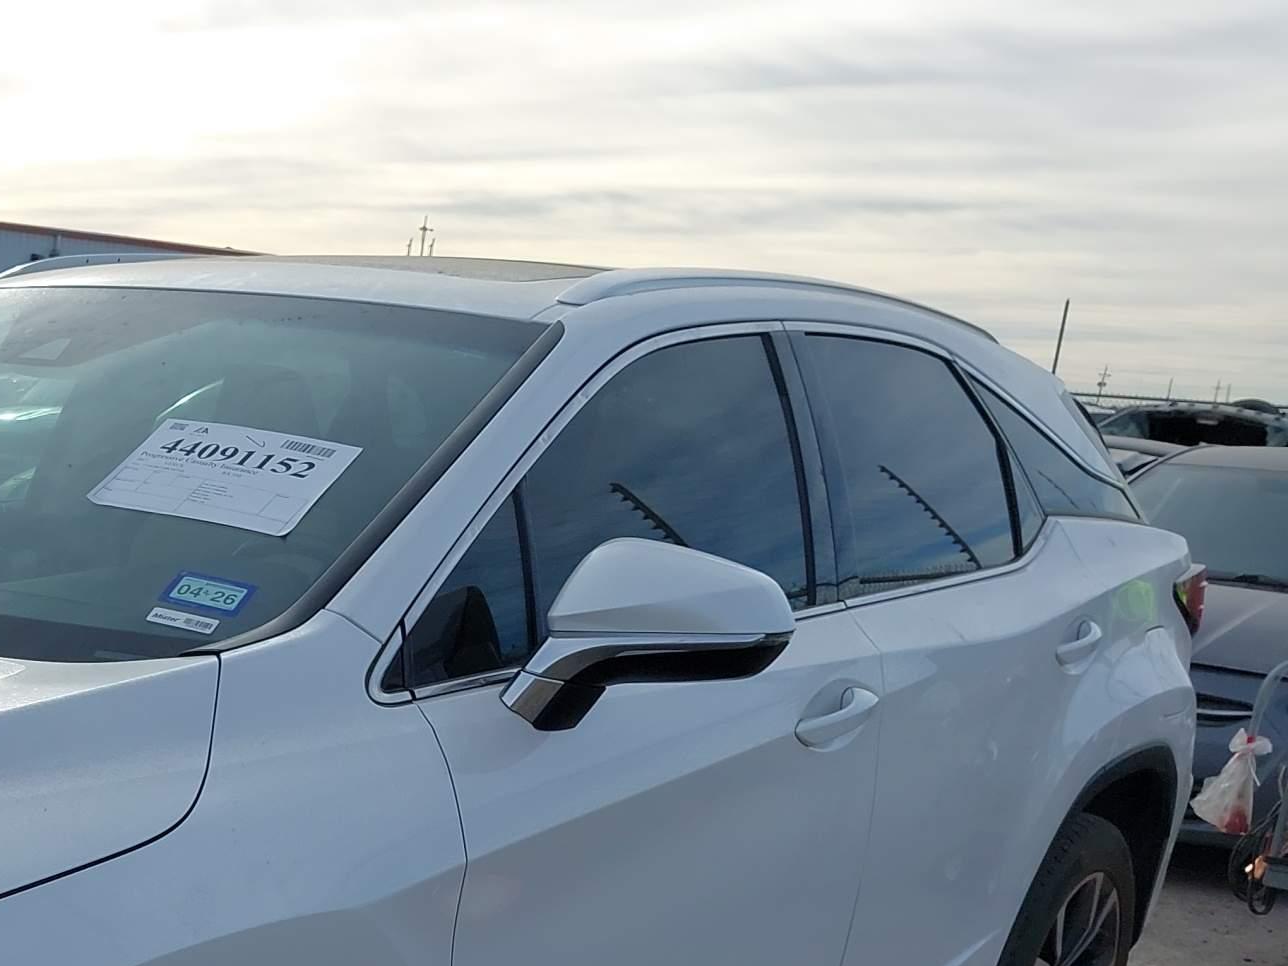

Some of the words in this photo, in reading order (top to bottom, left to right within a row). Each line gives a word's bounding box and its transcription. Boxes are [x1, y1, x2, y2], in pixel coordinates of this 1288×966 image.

[160, 438, 316, 479] 44091152
[177, 585, 203, 598] 04
[210, 591, 238, 605] 26
